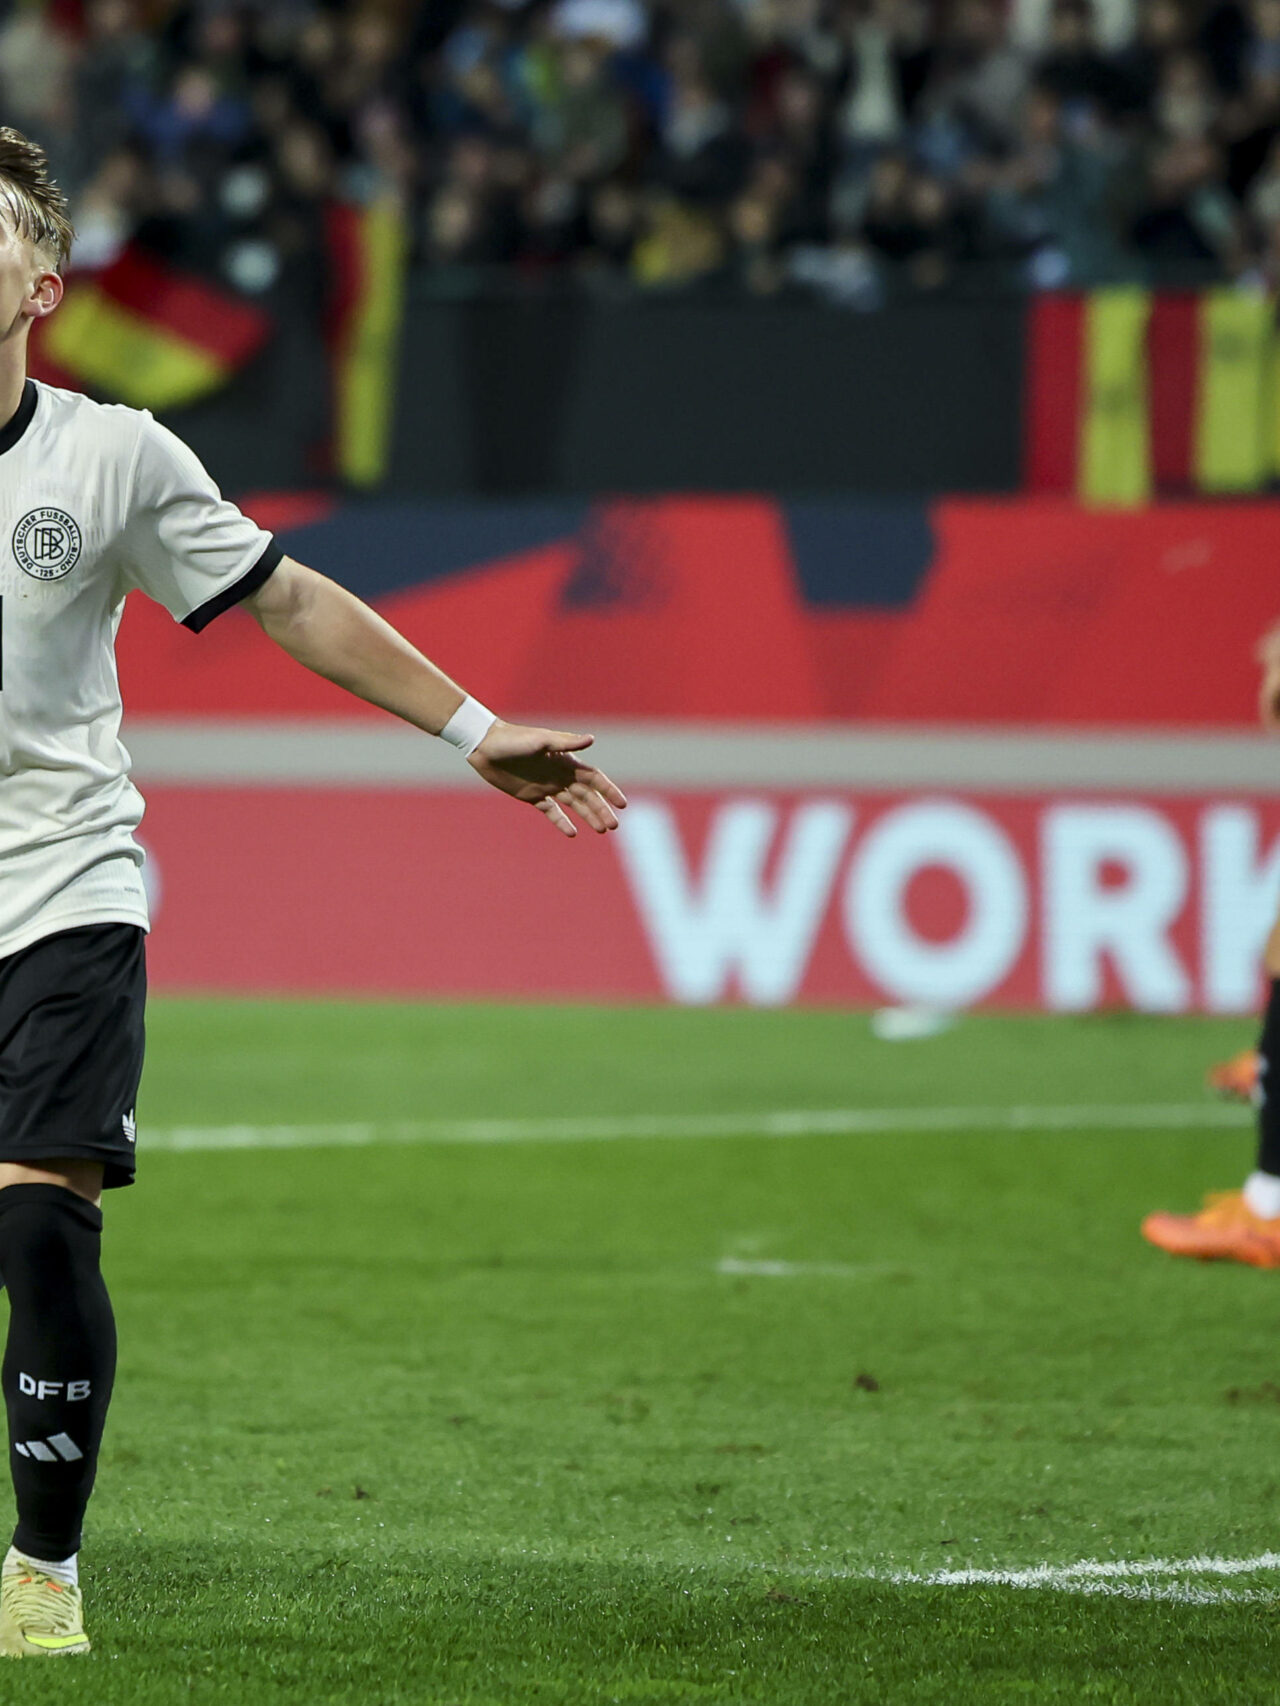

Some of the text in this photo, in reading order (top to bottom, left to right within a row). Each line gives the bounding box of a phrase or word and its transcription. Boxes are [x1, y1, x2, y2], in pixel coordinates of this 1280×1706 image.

[16, 514, 37, 570] DEUTSCHER
[39, 569, 54, 577] 125
[19, 1371, 92, 1402] DFB
